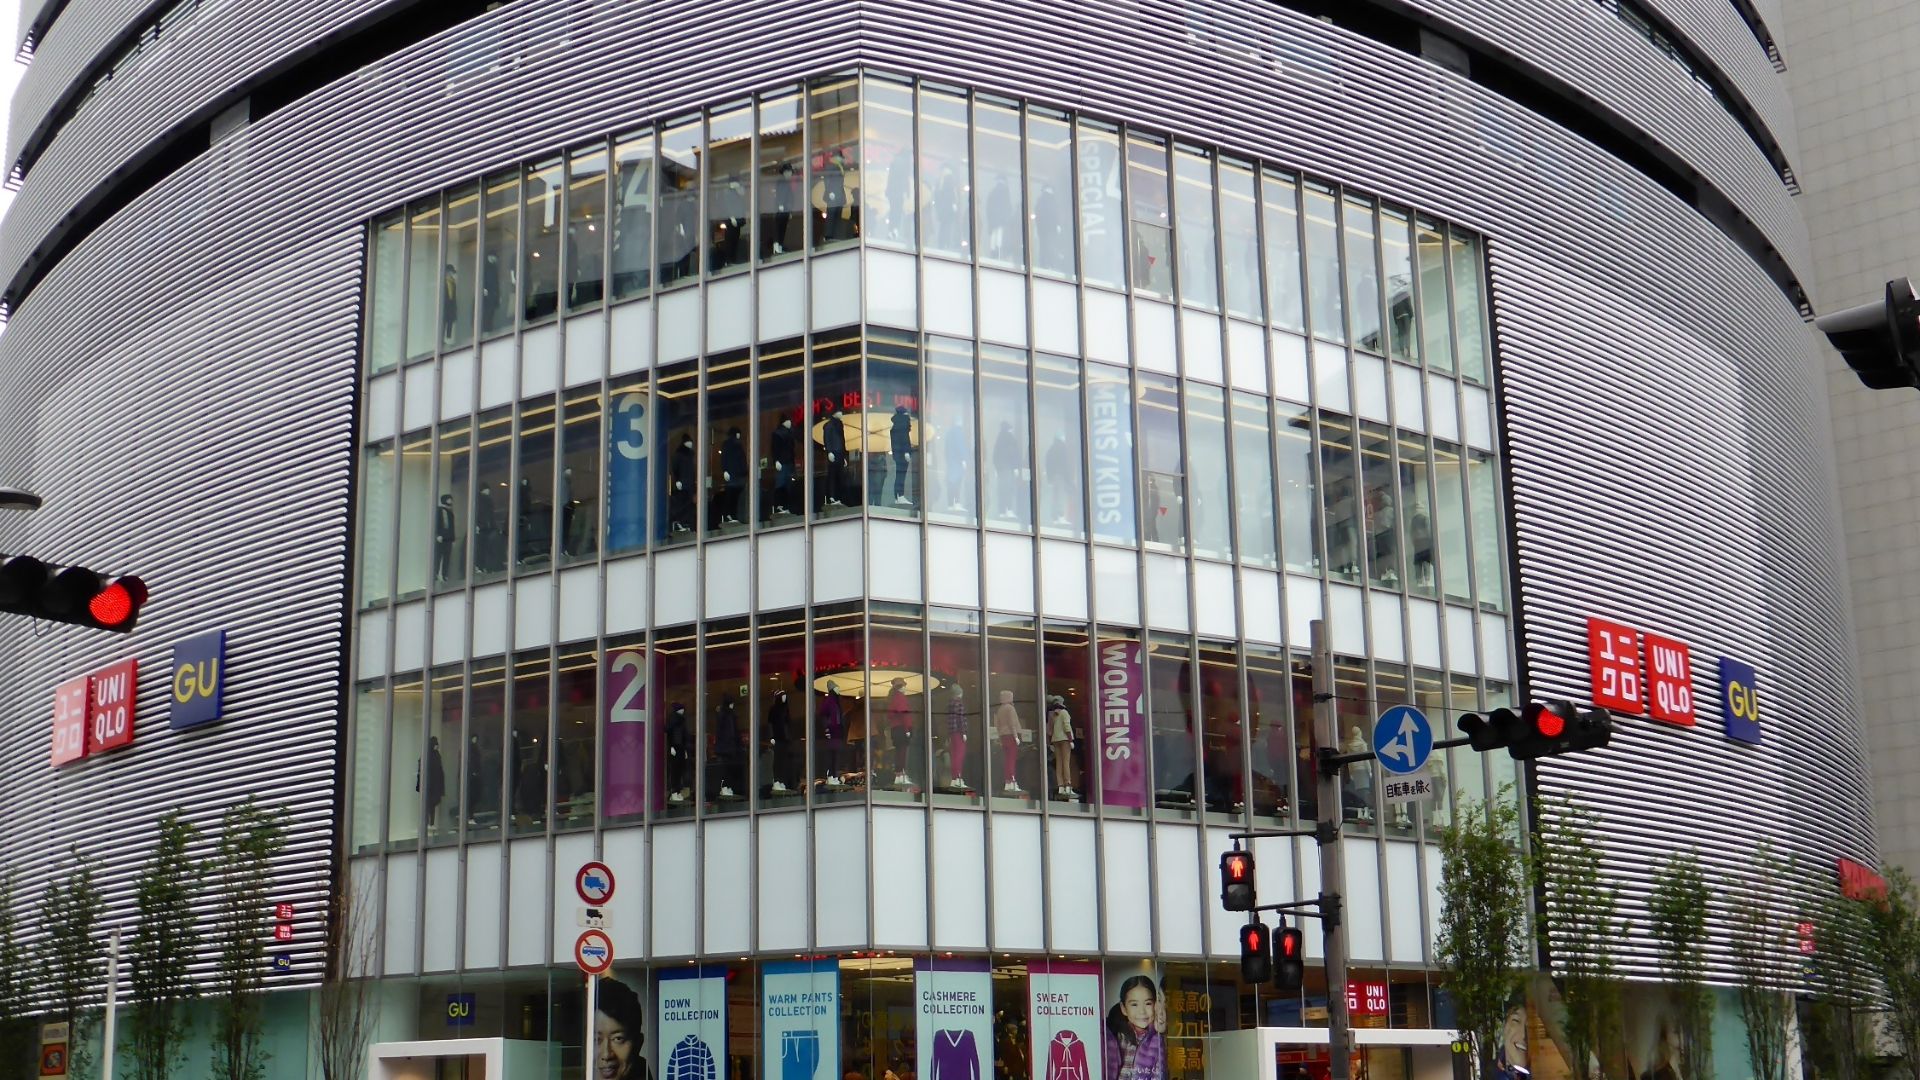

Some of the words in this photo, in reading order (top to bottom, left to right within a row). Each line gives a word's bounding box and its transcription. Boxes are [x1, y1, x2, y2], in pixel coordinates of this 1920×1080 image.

[1080, 142, 1107, 246] SPECIAL
[617, 392, 649, 460] 3
[1600, 630, 1634, 666] ユニ
[1653, 645, 1685, 680] UNI
[97, 672, 126, 707] UNI
[174, 657, 217, 704] GU
[610, 651, 646, 723] 2
[1602, 667, 1637, 701] クロ
[58, 688, 82, 721] ユニ
[1103, 643, 1131, 761] WOMENS
[1656, 680, 1690, 715] QLO
[1728, 680, 1759, 722] GU
[95, 706, 126, 745] QLO
[1386, 780, 1431, 799] 自転車を除く
[278, 958, 290, 966] GU
[664, 998, 691, 1009] DOWN
[768, 994, 797, 1004] WARM
[801, 992, 833, 1003] PANTS
[922, 991, 976, 1001] CASHMERE
[1036, 993, 1069, 1003] SWEAT
[1366, 984, 1383, 997] UNI
[448, 1002, 469, 1017] GU
[664, 1009, 719, 1021] COLLECTION
[768, 1005, 827, 1017] COLLECTON
[923, 1004, 985, 1015] COLLECTION
[1037, 1005, 1094, 1016] COLLECTION
[1367, 998, 1386, 1012] QLO
